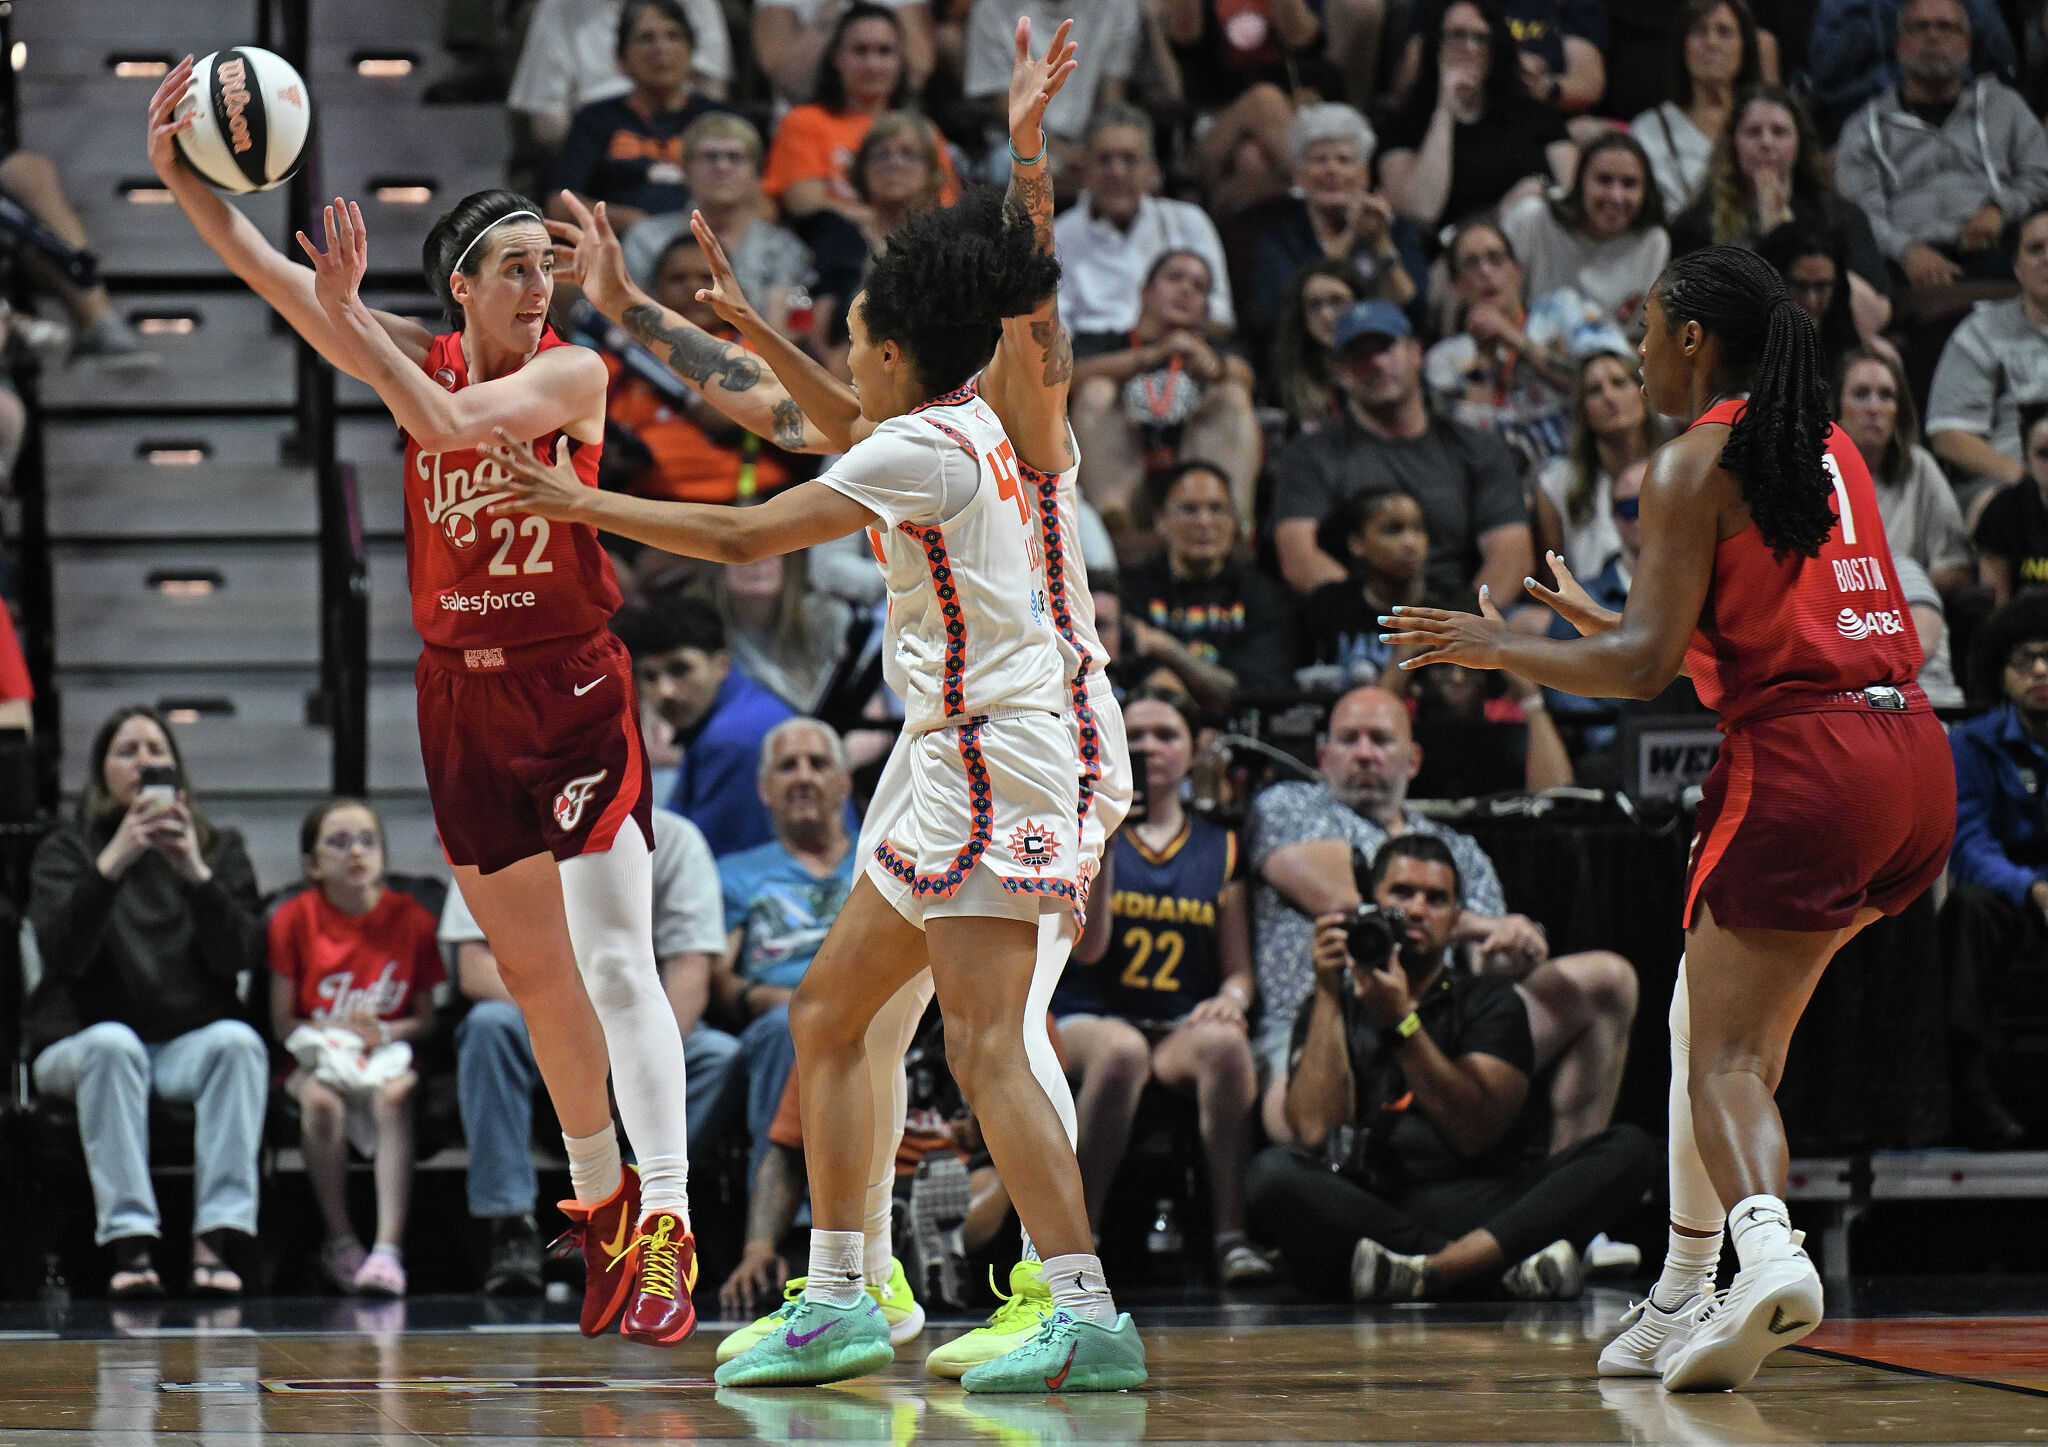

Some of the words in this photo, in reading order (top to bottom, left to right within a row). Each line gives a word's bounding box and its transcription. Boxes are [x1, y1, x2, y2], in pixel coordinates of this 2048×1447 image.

[217, 57, 252, 155] Wilson
[488, 515, 553, 576] 22
[1832, 556, 1887, 592] BOSTON
[440, 590, 536, 616] salesforce
[464, 648, 503, 659] EXPECT
[465, 659, 480, 668] TO
[480, 657, 505, 668] WIN
[1110, 890, 1216, 928] NDIANA
[1121, 926, 1185, 992] 22
